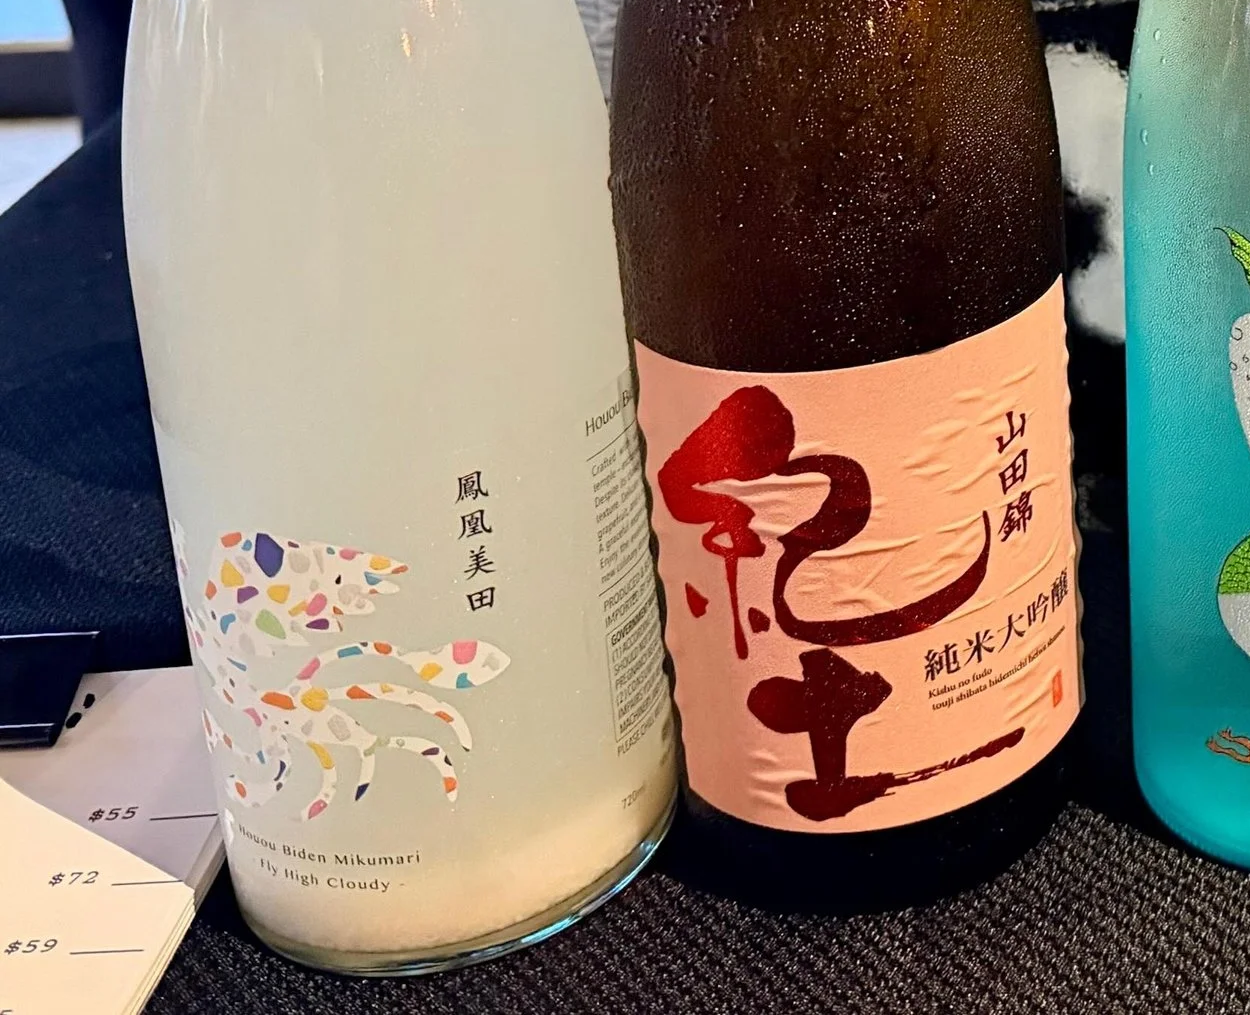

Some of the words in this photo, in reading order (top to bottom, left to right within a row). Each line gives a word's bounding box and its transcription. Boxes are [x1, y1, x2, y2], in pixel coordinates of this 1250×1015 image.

[995, 410, 1033, 542] 山田錦
[455, 470, 497, 612] 鳳凰美田
[928, 683, 957, 699] Kishu
[958, 678, 971, 688] no
[971, 668, 993, 683] fudo
[956, 685, 988, 702] shibata
[88, 806, 139, 823] $55
[238, 823, 277, 851] Houou
[282, 843, 326, 864] Biden
[334, 850, 421, 866] Mikumari
[48, 870, 99, 887] $72
[260, 857, 278, 876] Fly
[284, 867, 319, 887] High
[326, 876, 390, 893] Cloudy
[4, 938, 58, 955] $59
